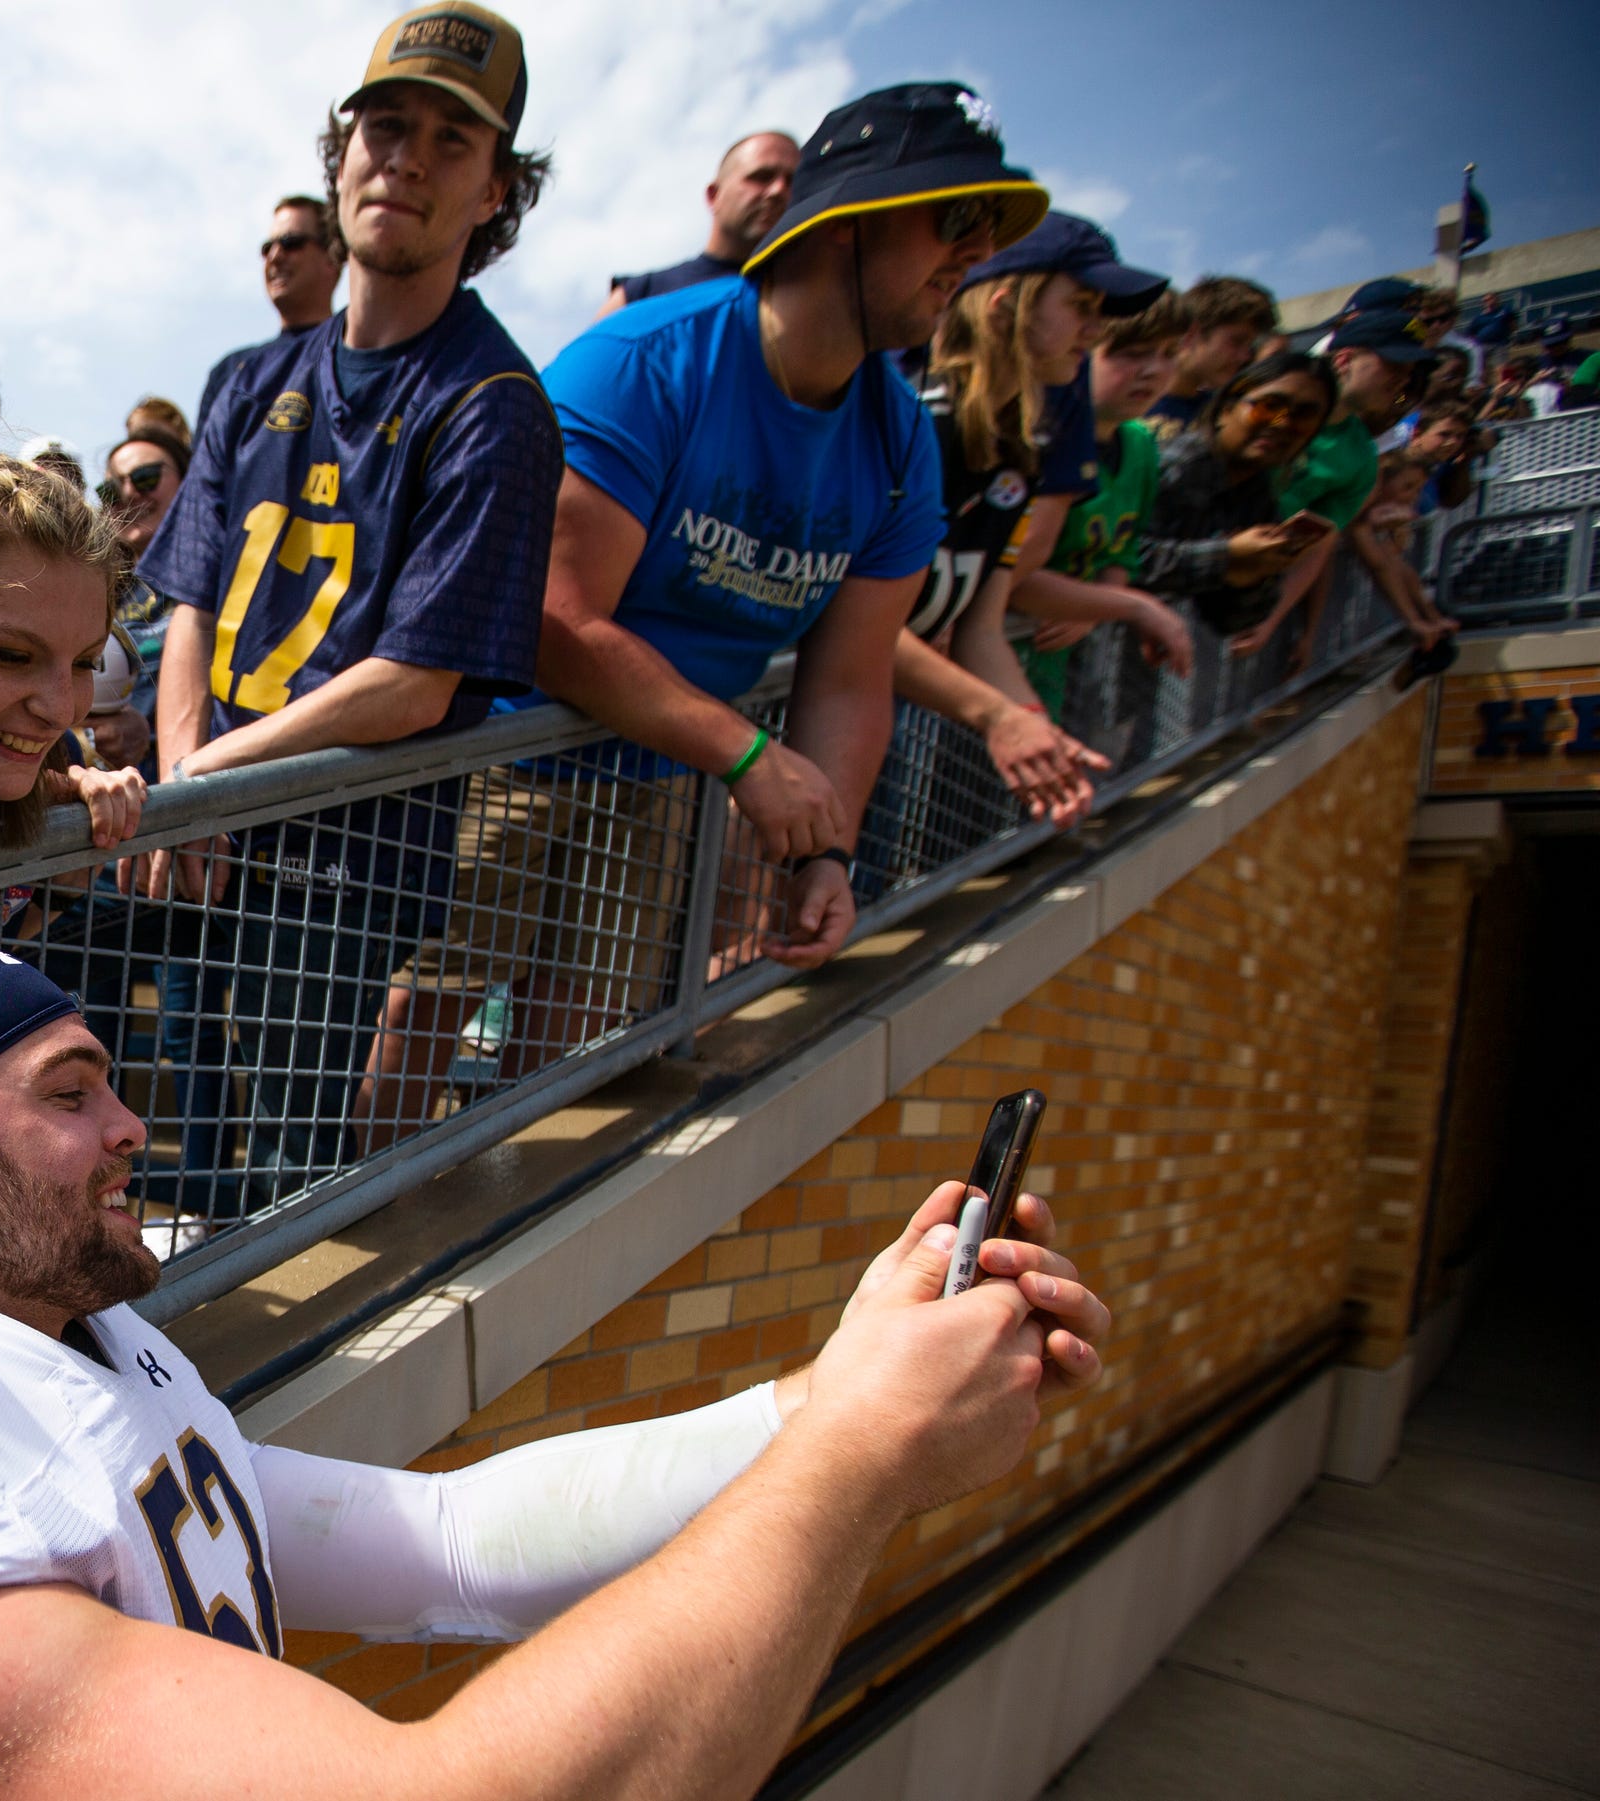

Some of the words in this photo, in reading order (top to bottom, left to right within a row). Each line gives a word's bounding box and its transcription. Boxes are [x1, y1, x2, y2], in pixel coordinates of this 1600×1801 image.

[671, 507, 761, 570] NOTRE
[211, 500, 355, 714] 17
[697, 548, 811, 610] Football
